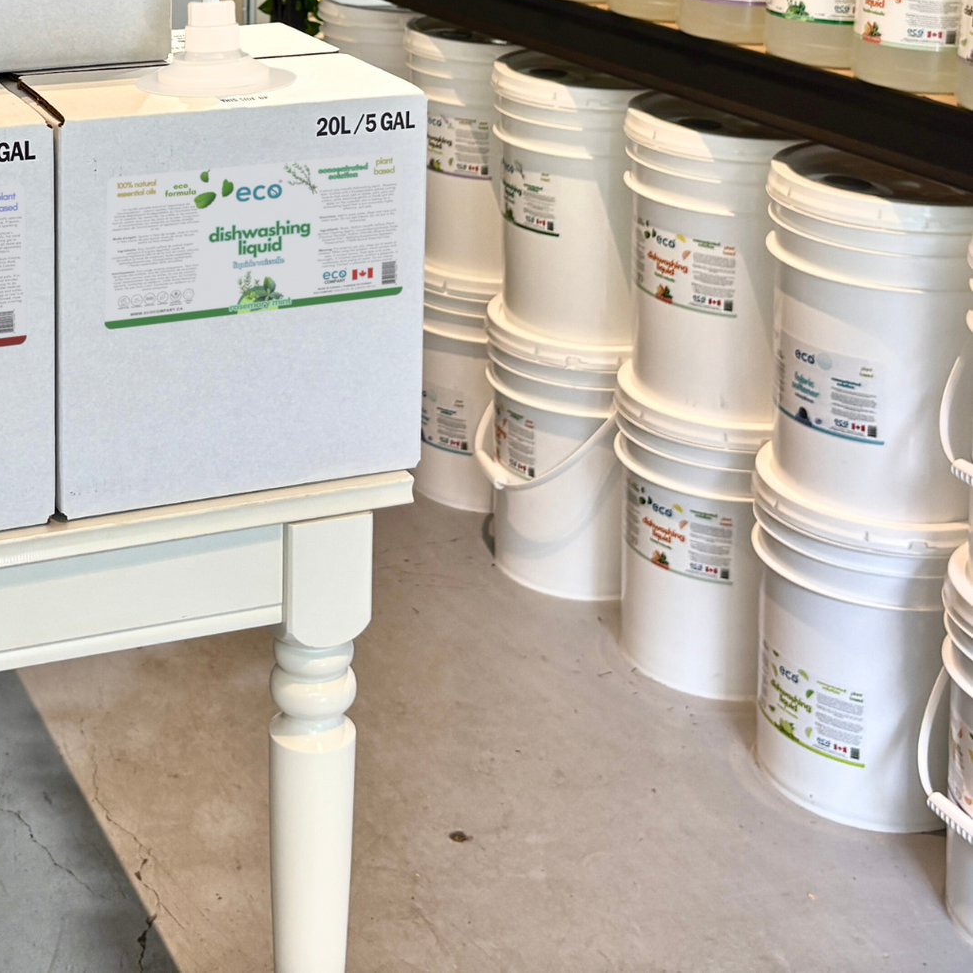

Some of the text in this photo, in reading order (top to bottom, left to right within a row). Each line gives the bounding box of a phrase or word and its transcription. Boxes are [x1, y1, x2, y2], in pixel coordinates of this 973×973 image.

[380, 110, 416, 131] GAL
[375, 157, 394, 166] plant
[373, 166, 395, 176] based
[134, 178, 157, 188] natural
[165, 189, 197, 198] formula
[235, 183, 283, 203] eco
[208, 220, 311, 244] dishwashing
[238, 236, 282, 259] liquid
[656, 235, 676, 249] eco
[322, 269, 347, 281] eco
[228, 296, 293, 313] rosemary mint
[794, 348, 815, 364] eco
[652, 502, 673, 518] eco
[779, 665, 799, 684] eco
